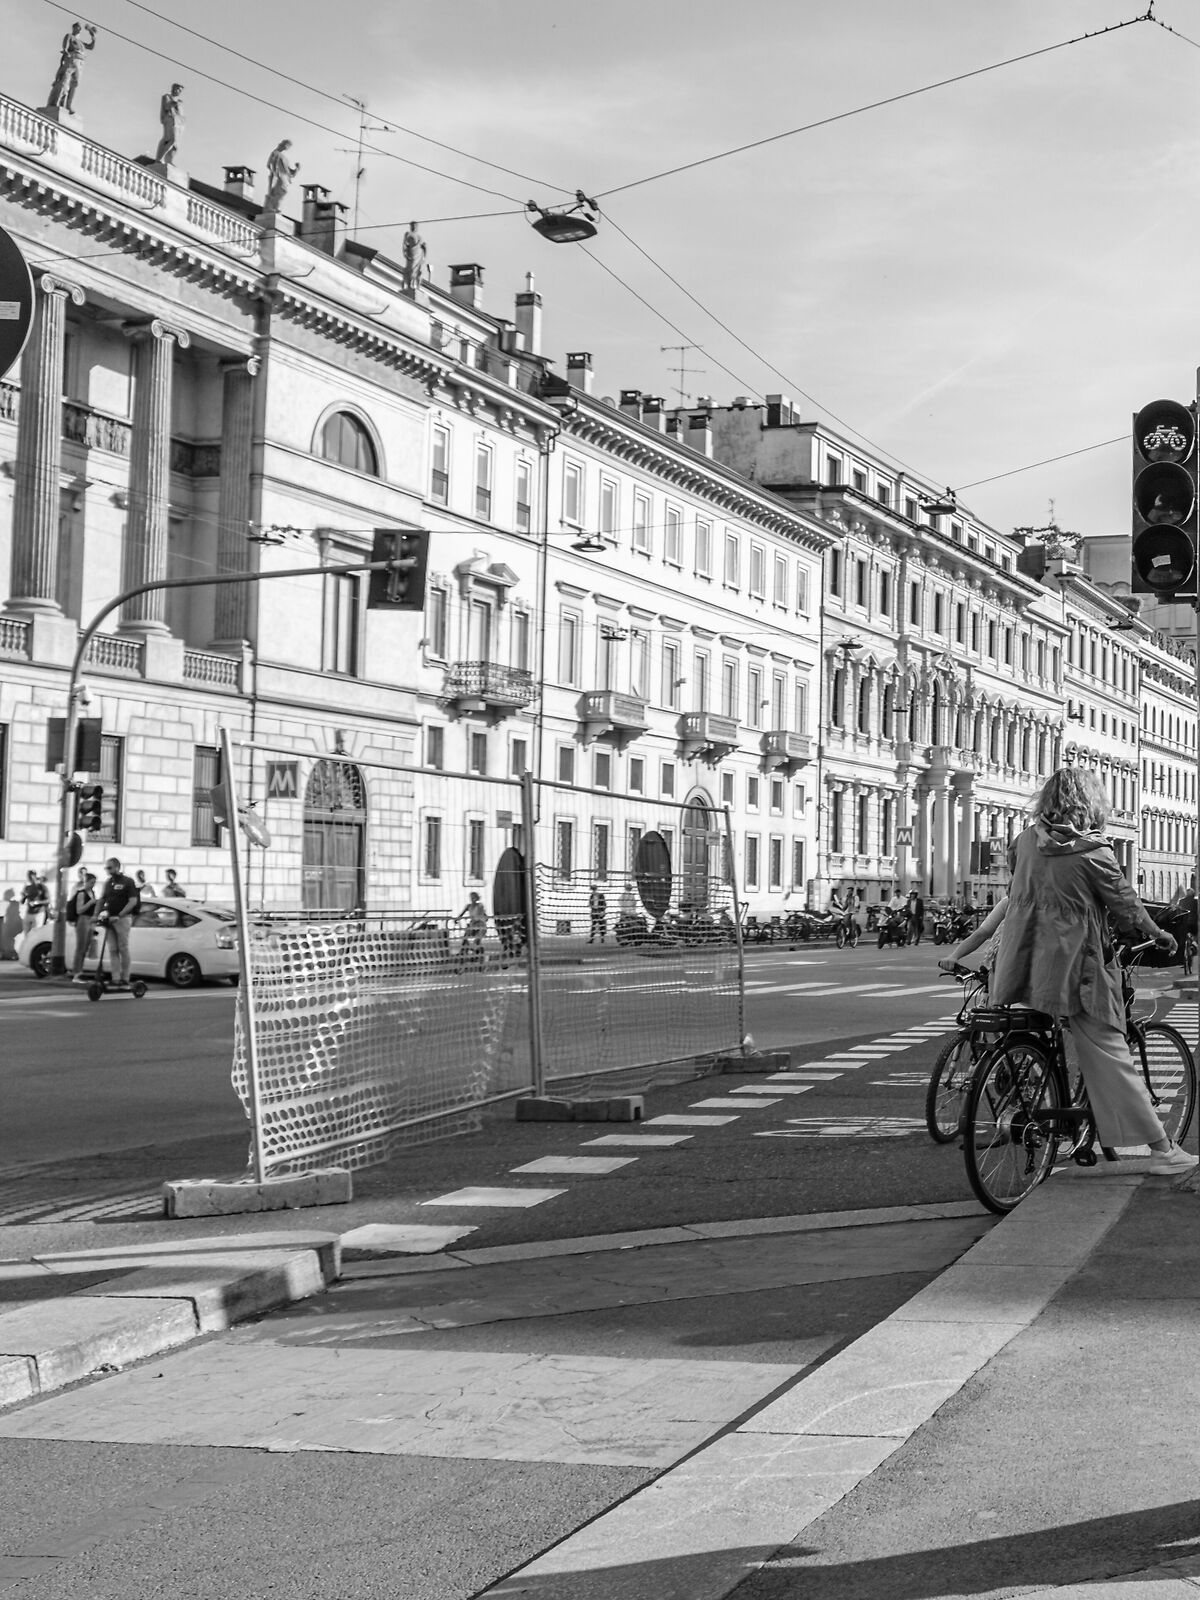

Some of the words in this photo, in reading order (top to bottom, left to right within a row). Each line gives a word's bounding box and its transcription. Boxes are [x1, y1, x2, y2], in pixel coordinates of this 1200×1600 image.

[270, 770, 295, 791] M
[897, 831, 912, 842] M
[990, 841, 1002, 851] M
